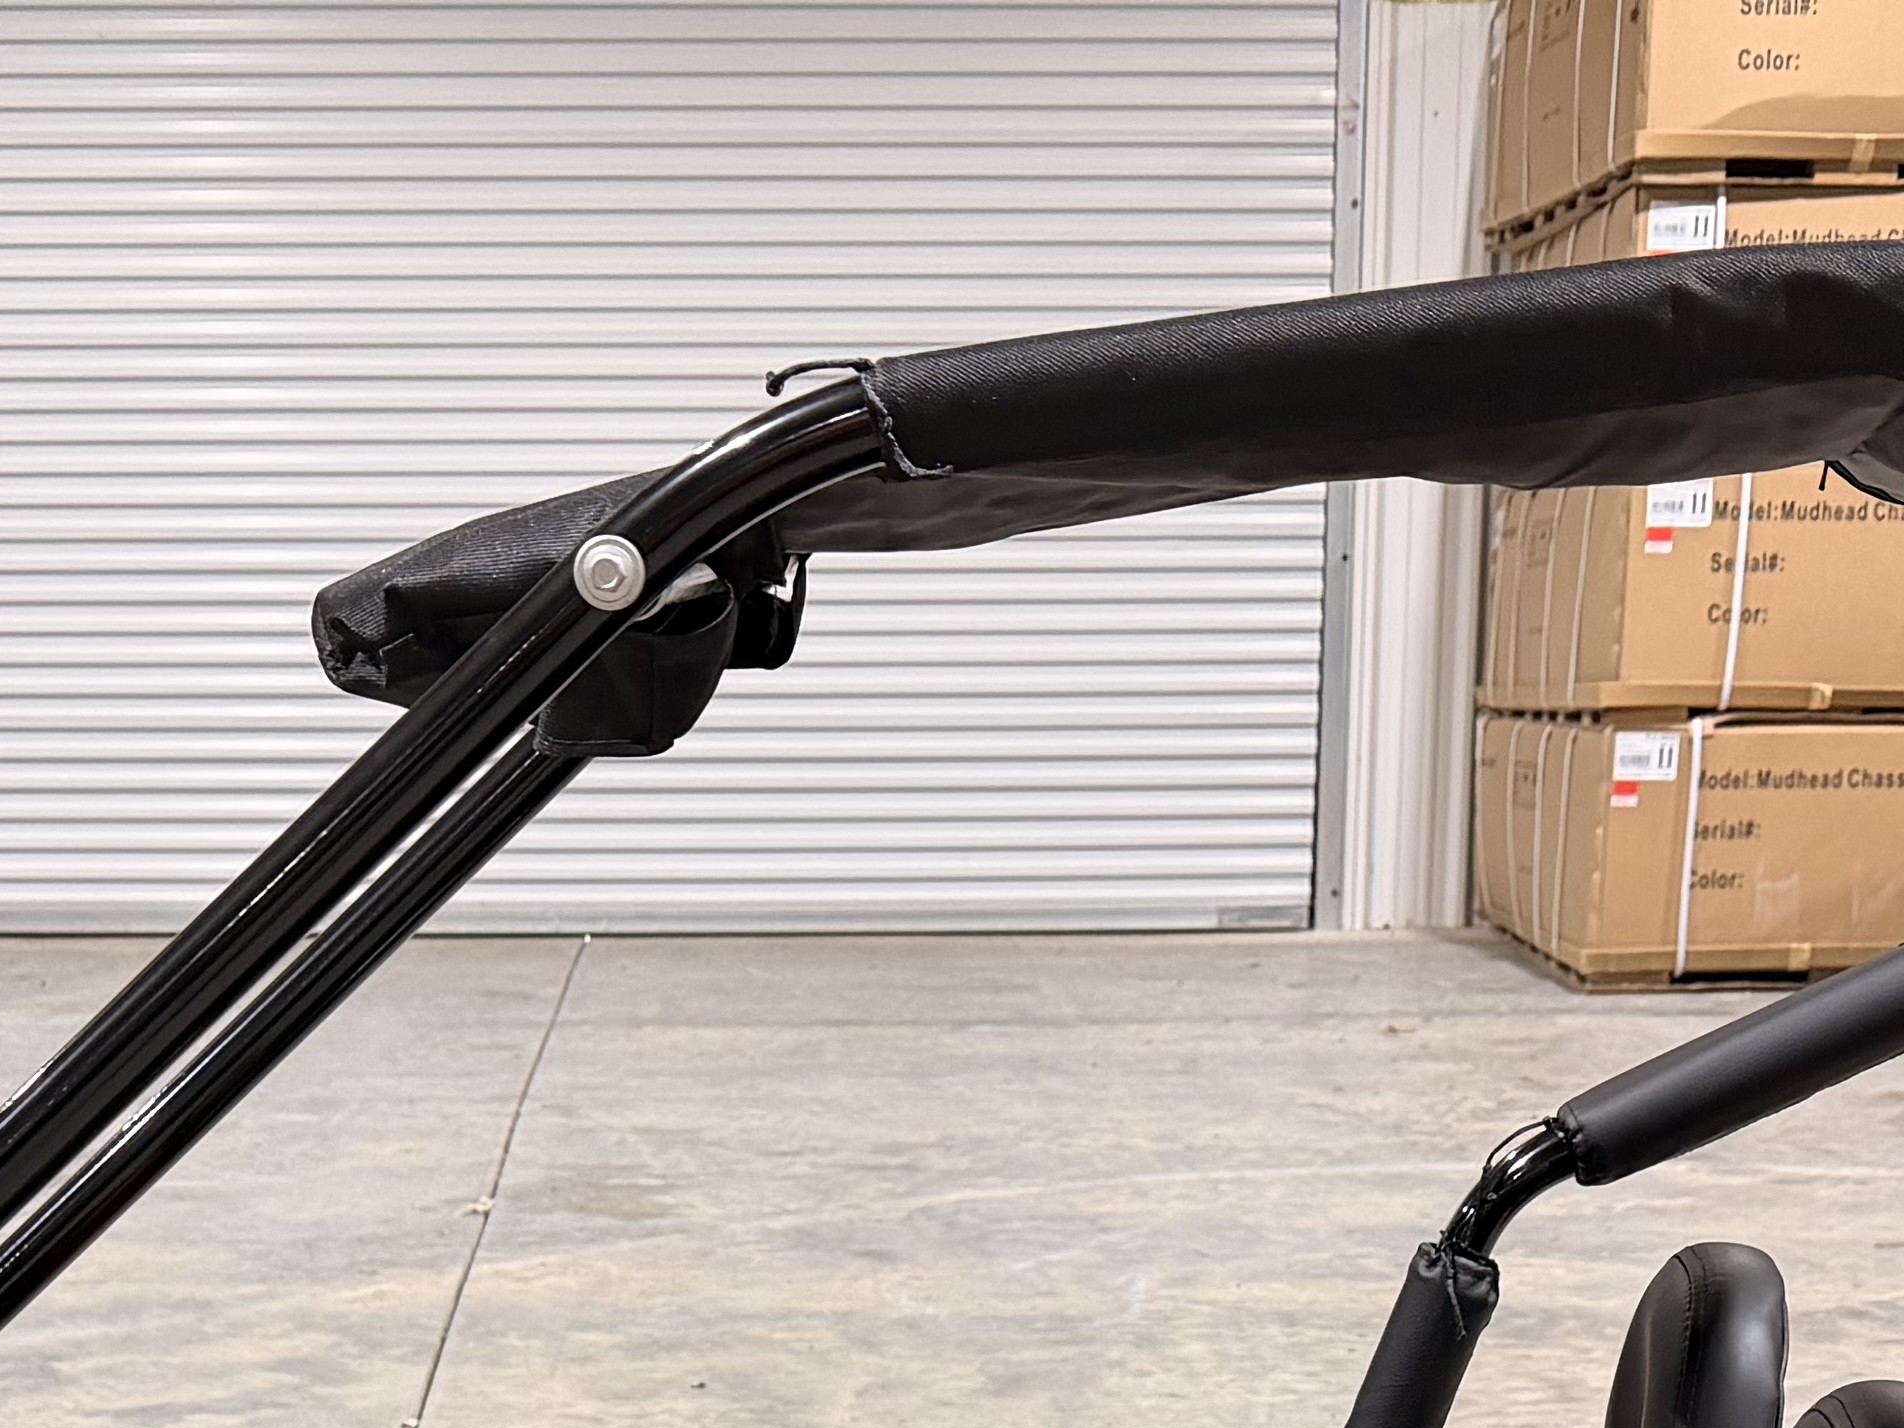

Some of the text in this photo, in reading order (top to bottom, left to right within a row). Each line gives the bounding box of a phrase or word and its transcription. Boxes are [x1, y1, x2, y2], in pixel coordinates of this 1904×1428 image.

[1737, 48, 1801, 71] Color:
[1710, 551, 1786, 573] Seial#:
[1707, 602, 1769, 625] Coor:
